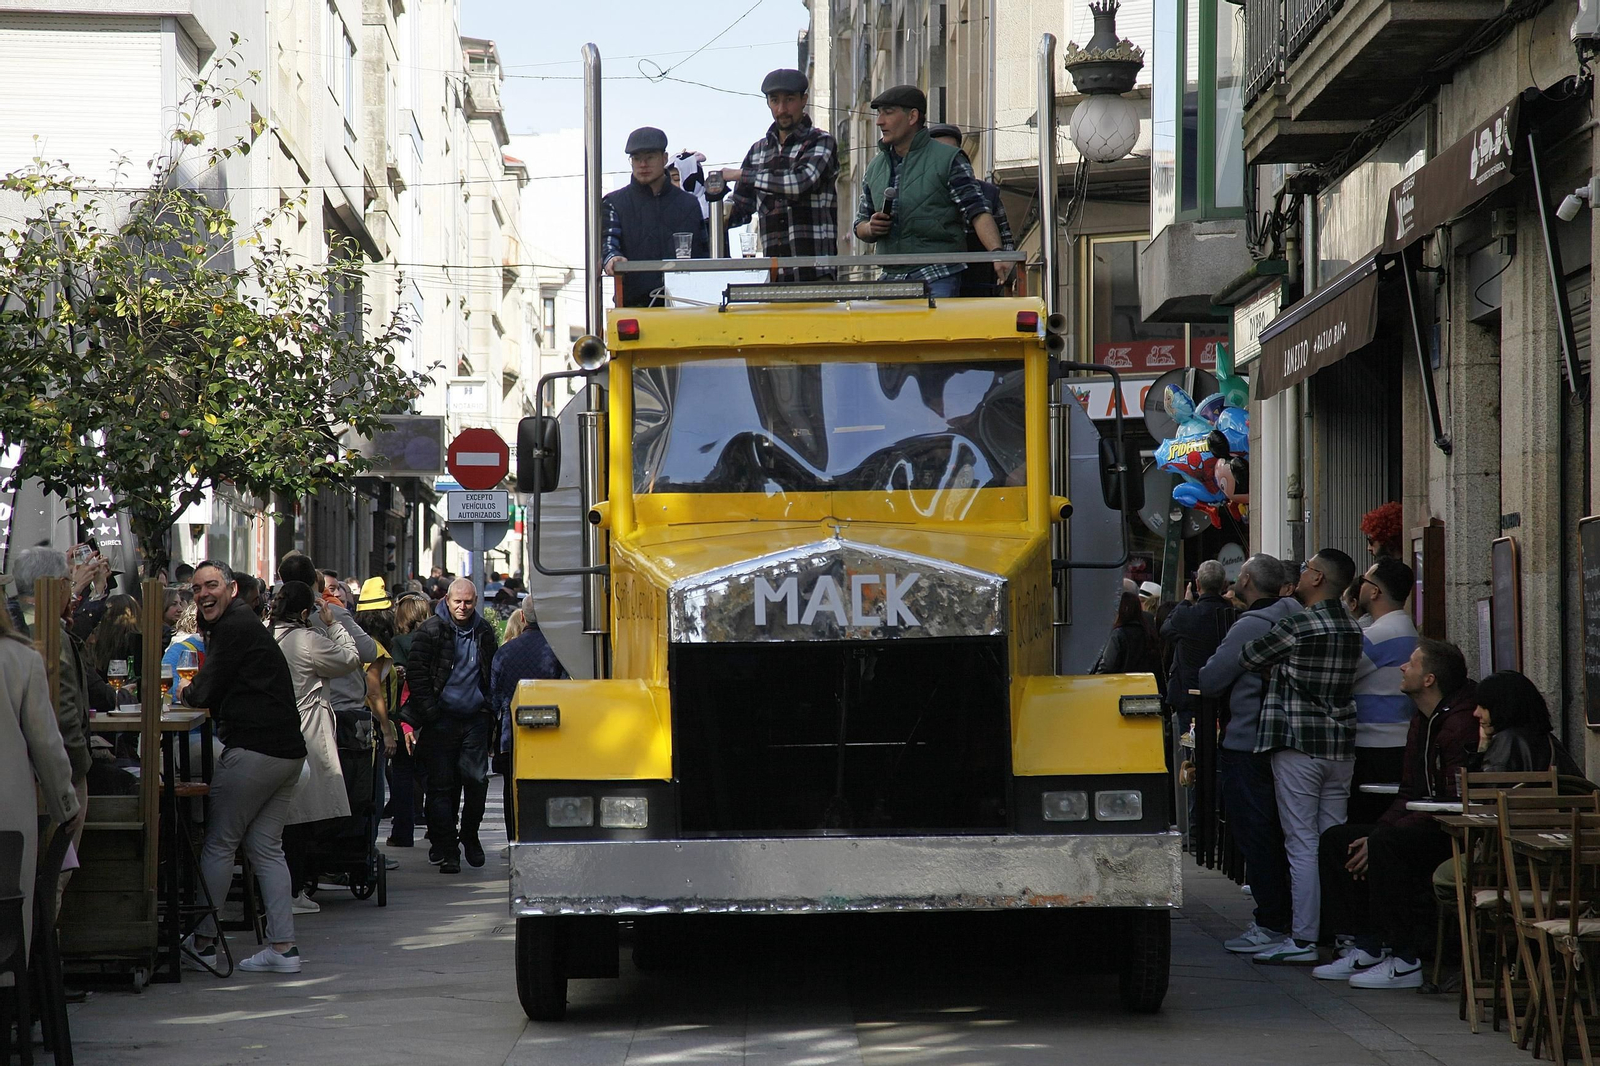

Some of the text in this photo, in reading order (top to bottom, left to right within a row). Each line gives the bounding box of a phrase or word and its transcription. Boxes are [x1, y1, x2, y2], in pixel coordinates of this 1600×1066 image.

[453, 402, 484, 410] NOTARIO
[1167, 439, 1210, 461] SPIDER-M
[461, 501, 496, 510] VEHÍCULOS
[458, 511, 501, 519] AUTORIZADOS
[754, 572, 921, 627] MACK
